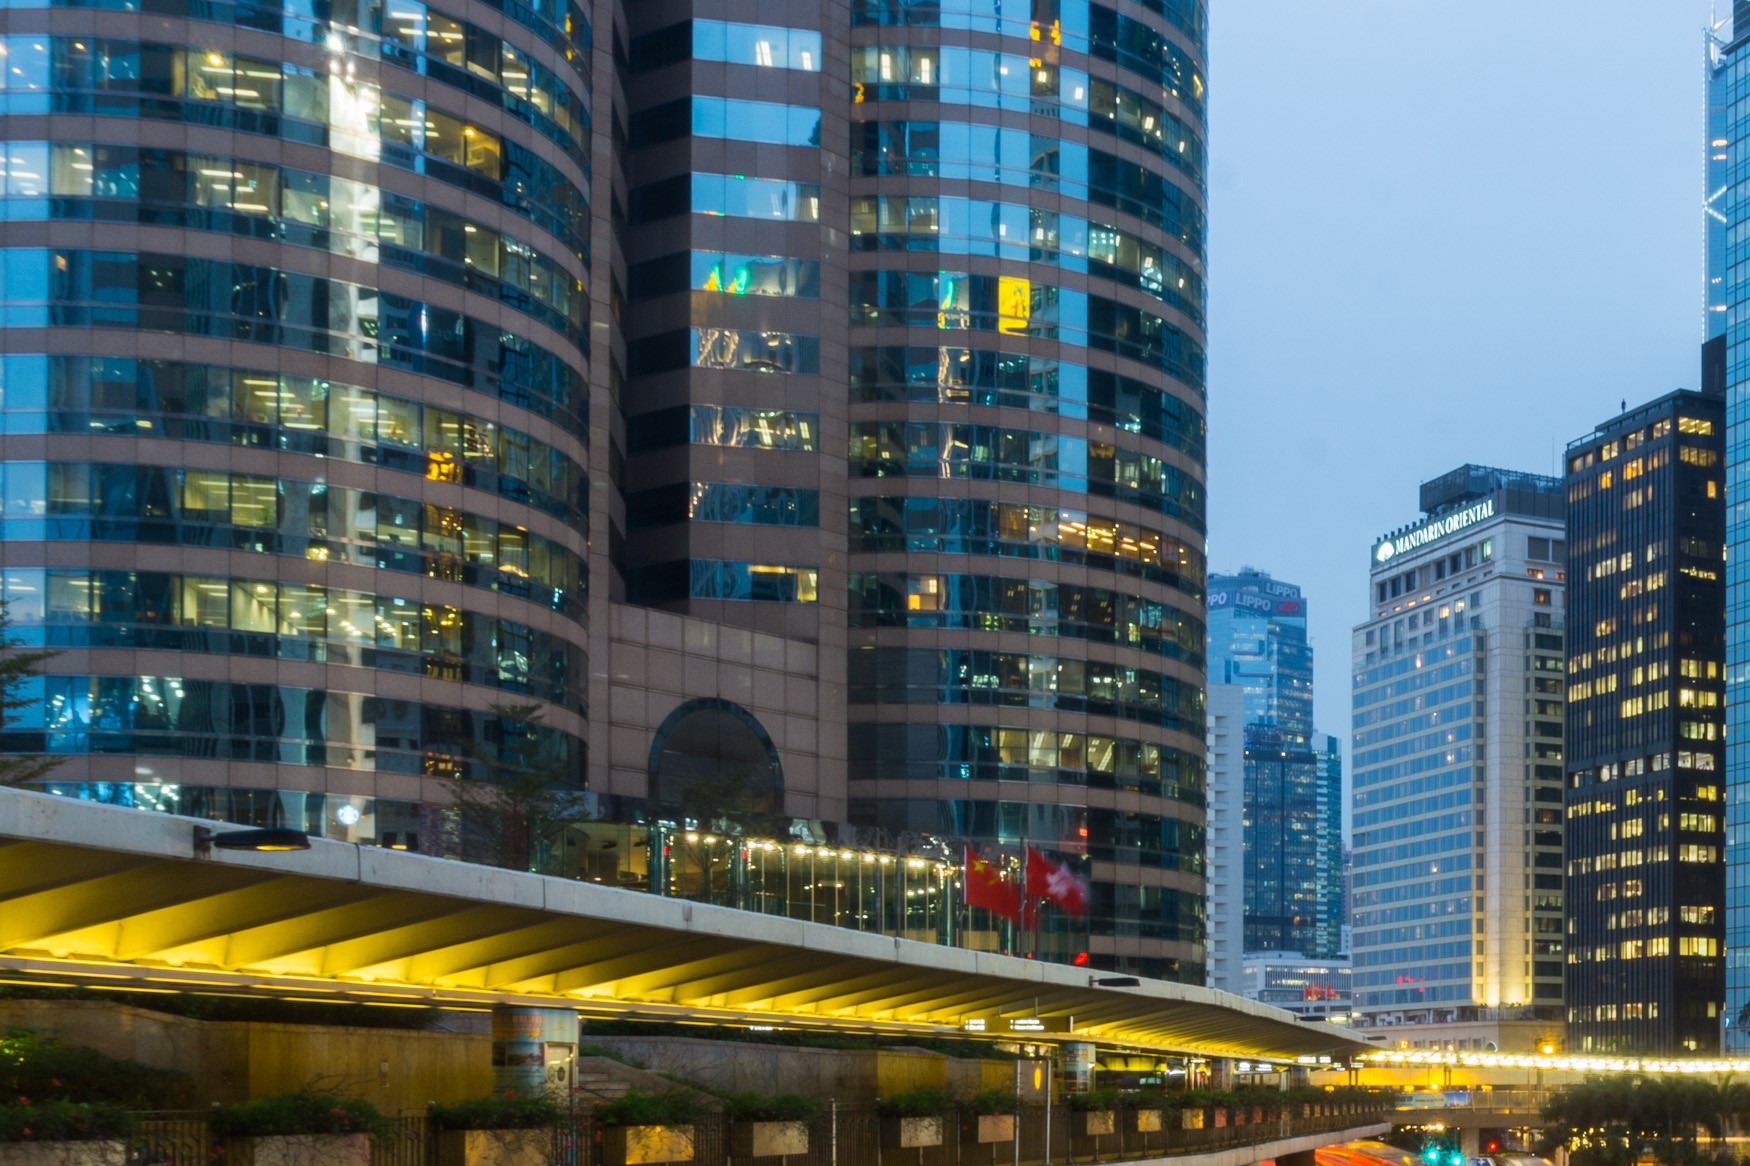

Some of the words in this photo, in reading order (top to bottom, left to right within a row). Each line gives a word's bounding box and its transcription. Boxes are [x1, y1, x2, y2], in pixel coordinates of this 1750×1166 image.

[1395, 519, 1445, 555] MANDARIN
[1445, 499, 1494, 534] ORIENTAL
[1266, 582, 1298, 599] LIPPO
[1235, 592, 1271, 612] LIPPO
